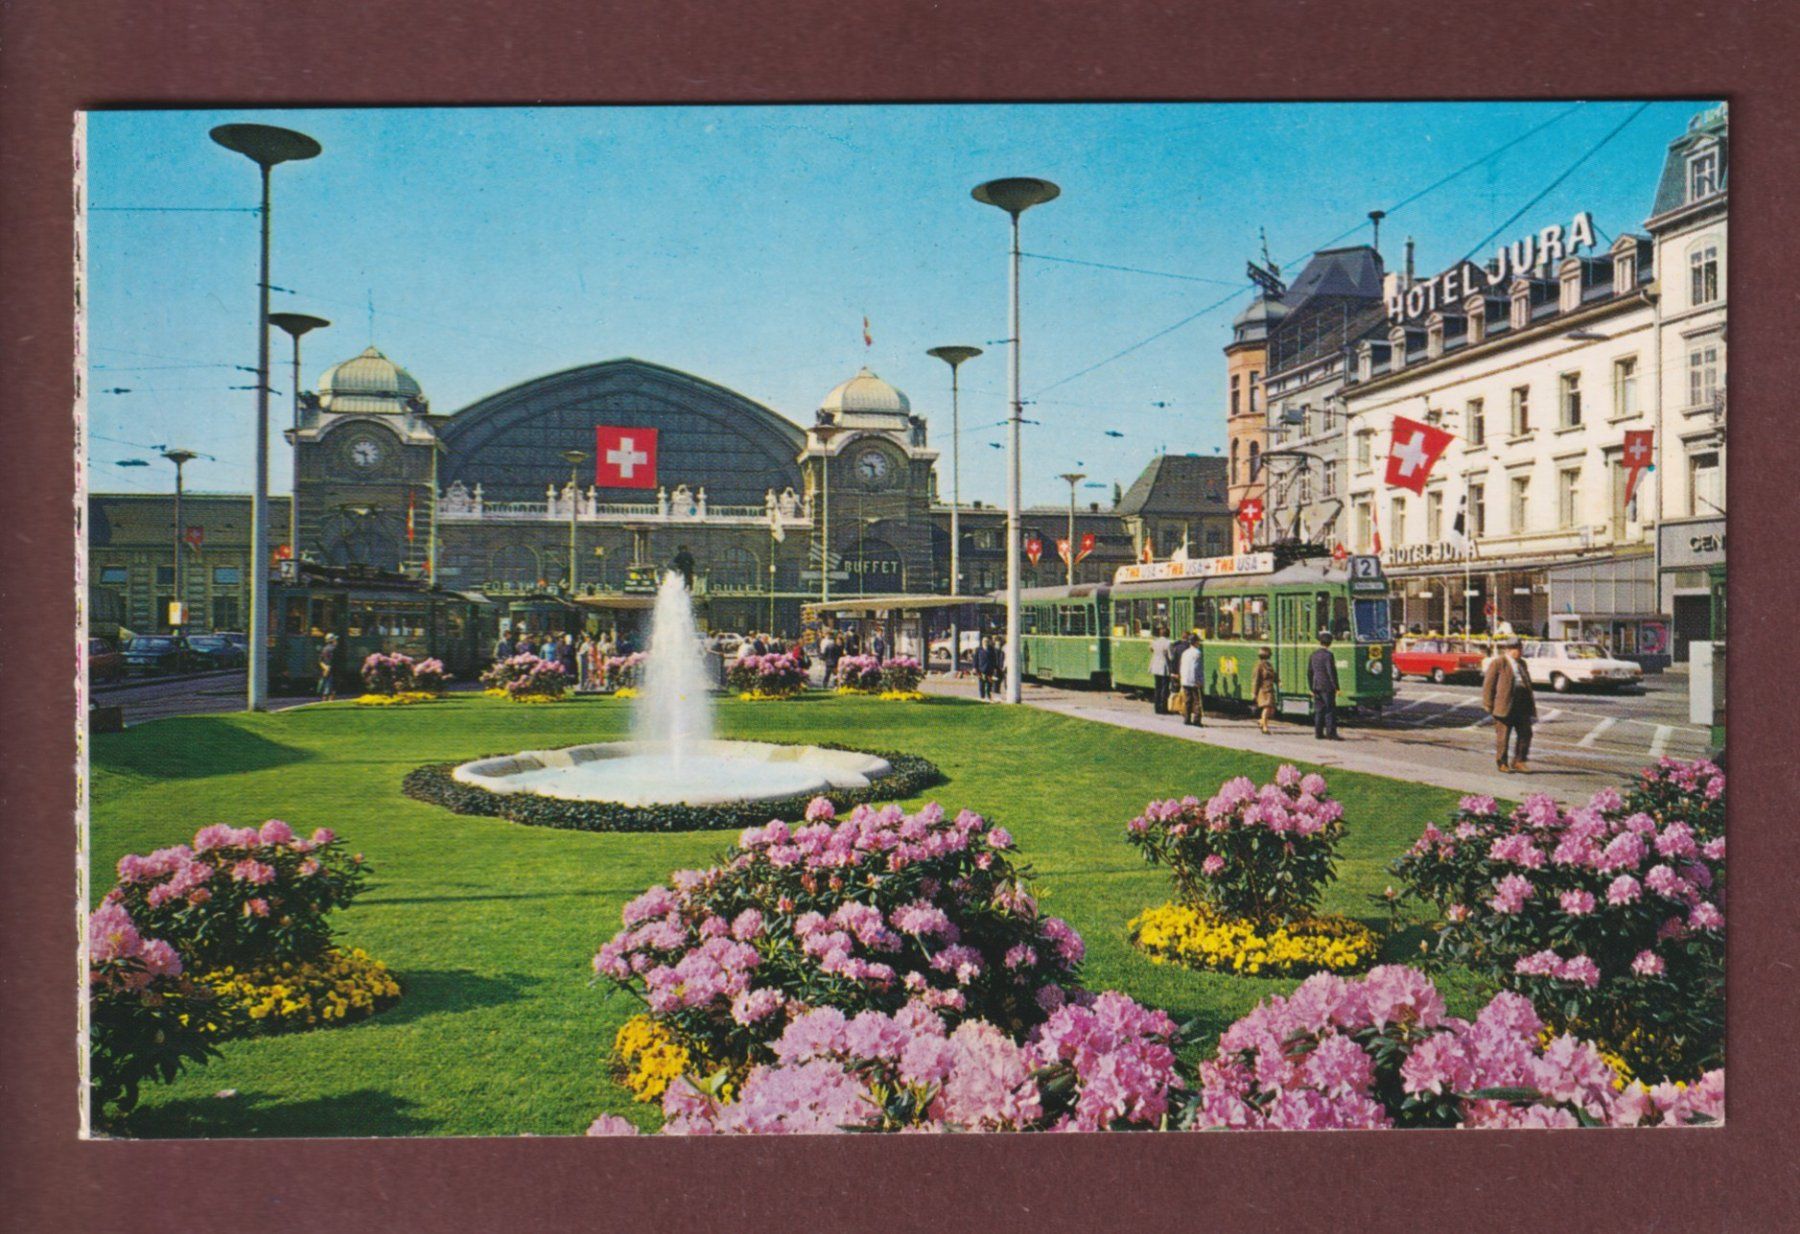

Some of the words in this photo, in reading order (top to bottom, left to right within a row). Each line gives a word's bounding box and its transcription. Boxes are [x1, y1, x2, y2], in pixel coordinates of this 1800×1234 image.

[1387, 263, 1480, 324] HOTEL
[1486, 211, 1597, 287] JURA
[1388, 543, 1433, 563] HOTEL
[844, 560, 899, 574] BUFFET
[1167, 562, 1184, 576] TWA
[1214, 558, 1235, 572] TWA
[1236, 556, 1258, 571] USA
[1360, 558, 1372, 576] 2
